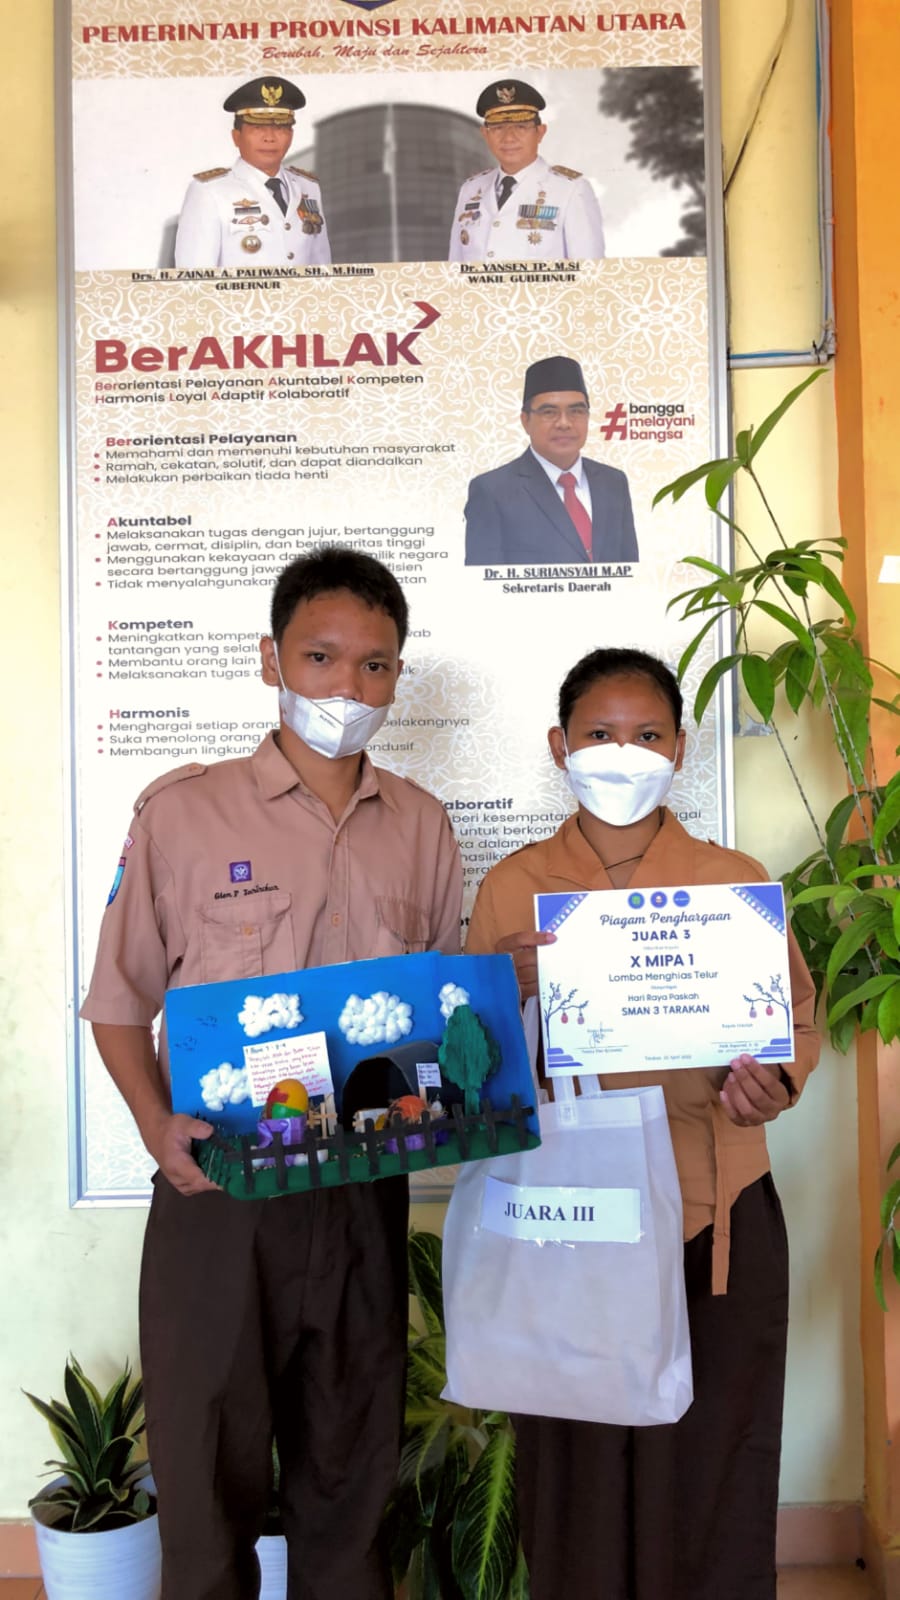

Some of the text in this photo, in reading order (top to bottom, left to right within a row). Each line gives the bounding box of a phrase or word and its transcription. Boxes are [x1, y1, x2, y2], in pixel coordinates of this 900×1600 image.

[82, 13, 686, 43] PEMERINTAH PROVINSI KALIMANTAN UTARA
[262, 44, 488, 59] Berubah, Maju dan Sejahtera
[131, 272, 156, 280] Drs.
[160, 271, 173, 279] H.
[177, 270, 215, 279] ZAINAL
[221, 269, 232, 278] A.
[333, 266, 374, 275] M.Hum
[460, 263, 478, 272] Dr.
[483, 263, 528, 271] YANSEN
[554, 261, 580, 271] M.Si
[468, 274, 576, 283] WAKIL GUBERNUR
[215, 281, 280, 291] GUBERNUR
[95, 332, 422, 373] BerAKHLAK
[95, 374, 424, 391] Berorientasi Pelayanan Akuntabel Kompeten
[95, 388, 350, 404] Harmonis Loyal Adaptif Kolaboratif
[629, 403, 685, 417] bangga
[629, 414, 695, 429] melayani
[106, 432, 297, 447] Berorientasi Pelayanan
[629, 428, 684, 442] bangsa
[106, 443, 455, 460] Memahami dan memenuhi kebutuhan masyarakat
[106, 456, 422, 472] Ramah, cekatan, solutif, dan dapat diandalkan
[106, 469, 328, 484] Melakukan perbaikan tiada henti
[107, 515, 192, 527] Akuntabel
[107, 525, 435, 540] Melaksanakan tugas dengan jujur, bertanggung
[107, 541, 151, 554] jawab,
[154, 541, 208, 551] cermat,
[210, 539, 261, 551] disiplin,
[265, 540, 292, 549] dan
[387, 537, 425, 549] tinggi
[107, 553, 205, 565] Menggunakan
[209, 552, 276, 564] kekayaan
[400, 551, 449, 562] negara
[107, 566, 154, 577] secara
[158, 565, 248, 577] bertanggung
[484, 565, 632, 579] Dr. H. SURIANSYAH M.AP
[107, 579, 143, 589] Tidak
[146, 578, 278, 590] menyalahgunakan
[502, 581, 611, 594] Sekretaris Daerah
[108, 619, 193, 632] Kompeten
[108, 632, 204, 644] Meningkatkan
[108, 645, 180, 656] tantangan
[184, 645, 219, 656] yang
[108, 655, 256, 668] Membantu orang lain
[108, 669, 250, 680] Melaksanakan tugas
[109, 707, 190, 719] Harmonis
[109, 721, 192, 733] Menghargai
[196, 720, 238, 732] setiap
[110, 733, 261, 745] Suka menolong orang
[110, 746, 198, 757] Membangun
[365, 741, 414, 752] ondusif
[460, 826, 500, 836] untuk
[600, 911, 731, 929] Piagam Penghargaan
[632, 929, 692, 942] JUARA 3
[630, 953, 694, 968] X MIPA 1
[608, 970, 718, 982] Lomba Menghias Telur
[628, 992, 700, 1002] Hari Raya Paskah
[621, 1004, 710, 1016] SMAN 3 TARAKAN
[504, 1202, 595, 1221] JUARA III
